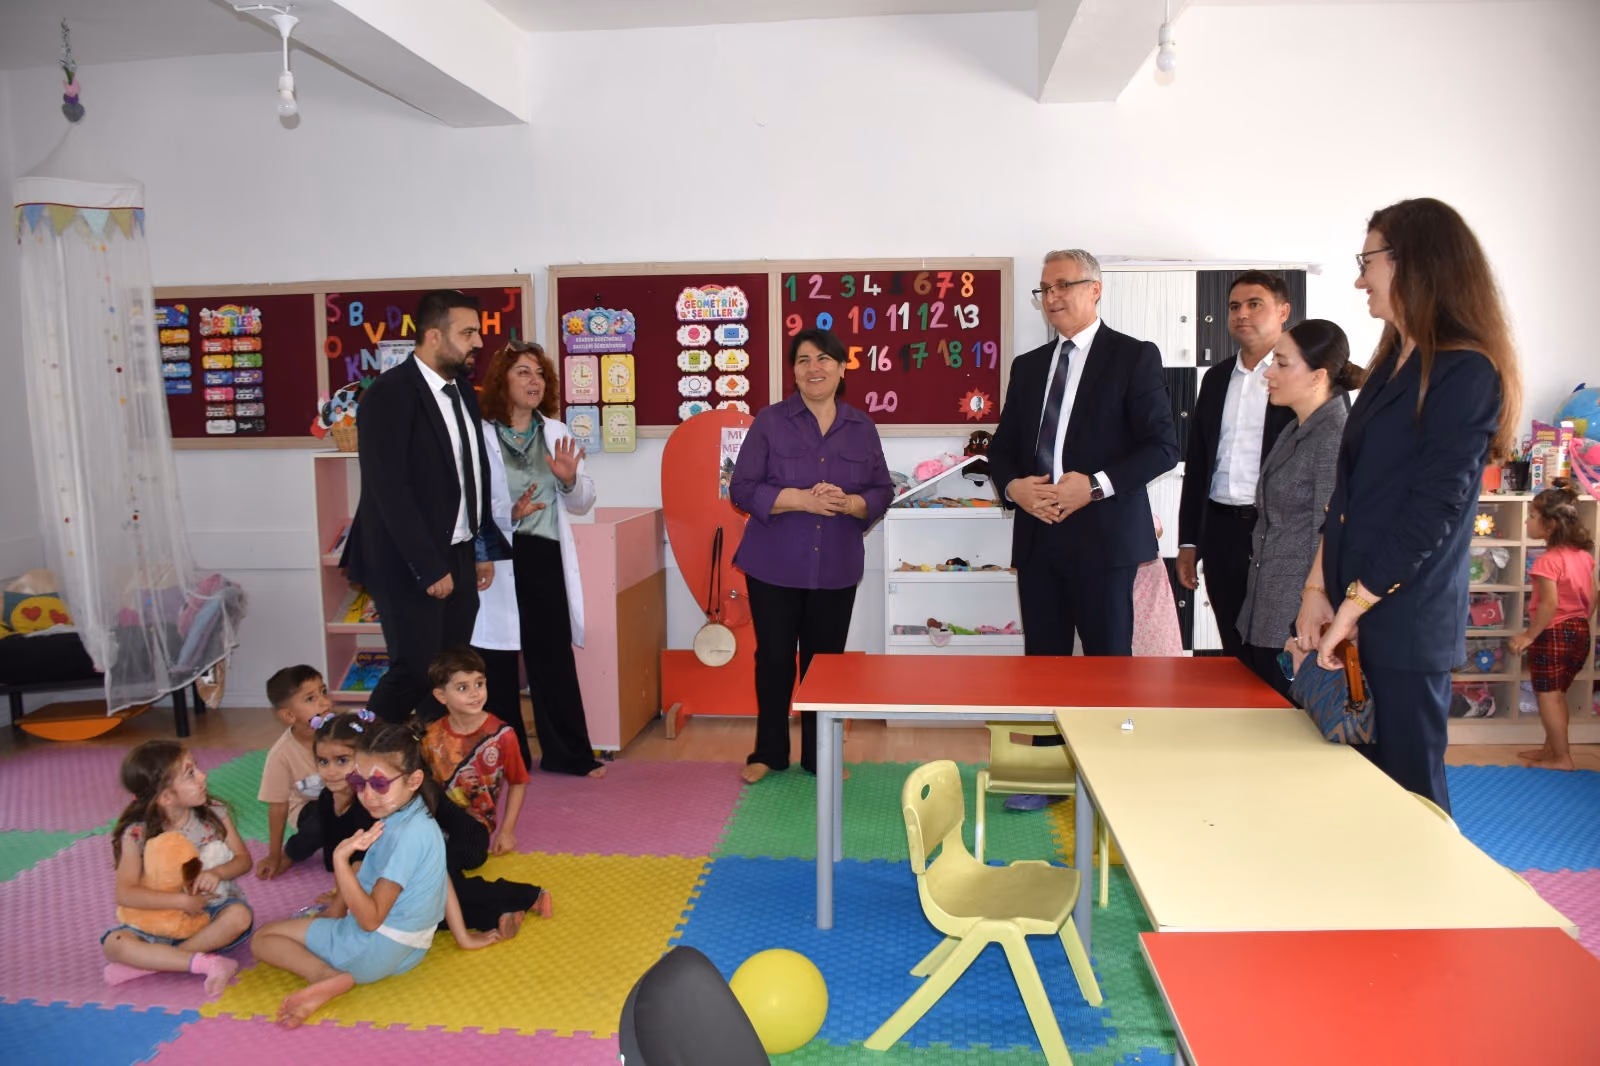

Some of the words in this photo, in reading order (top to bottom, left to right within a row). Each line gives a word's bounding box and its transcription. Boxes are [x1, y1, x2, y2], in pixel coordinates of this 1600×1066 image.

[784, 274, 796, 302] 1
[808, 274, 832, 299] 2
[840, 274, 856, 298] 3
[863, 274, 882, 296] 4
[913, 271, 932, 295] 6
[936, 271, 954, 299] 7
[961, 271, 974, 297] 8
[325, 293, 341, 322] S
[502, 288, 521, 312] J
[684, 297, 738, 309] GEOMETRİK
[349, 301, 363, 326] B
[482, 311, 501, 335] H
[691, 308, 733, 319] ŞEKİLLER
[786, 313, 803, 336] 9
[848, 305, 876, 333] 10
[886, 301, 909, 331] 11
[917, 301, 948, 330] 12
[954, 304, 980, 329] 13
[363, 321, 386, 344] V
[324, 336, 342, 358] O
[360, 348, 381, 370] N
[867, 345, 892, 371] 16
[898, 342, 929, 372] 17
[937, 338, 963, 368] 18
[971, 341, 997, 369] 19
[345, 353, 362, 381] K
[865, 391, 898, 412] 20
